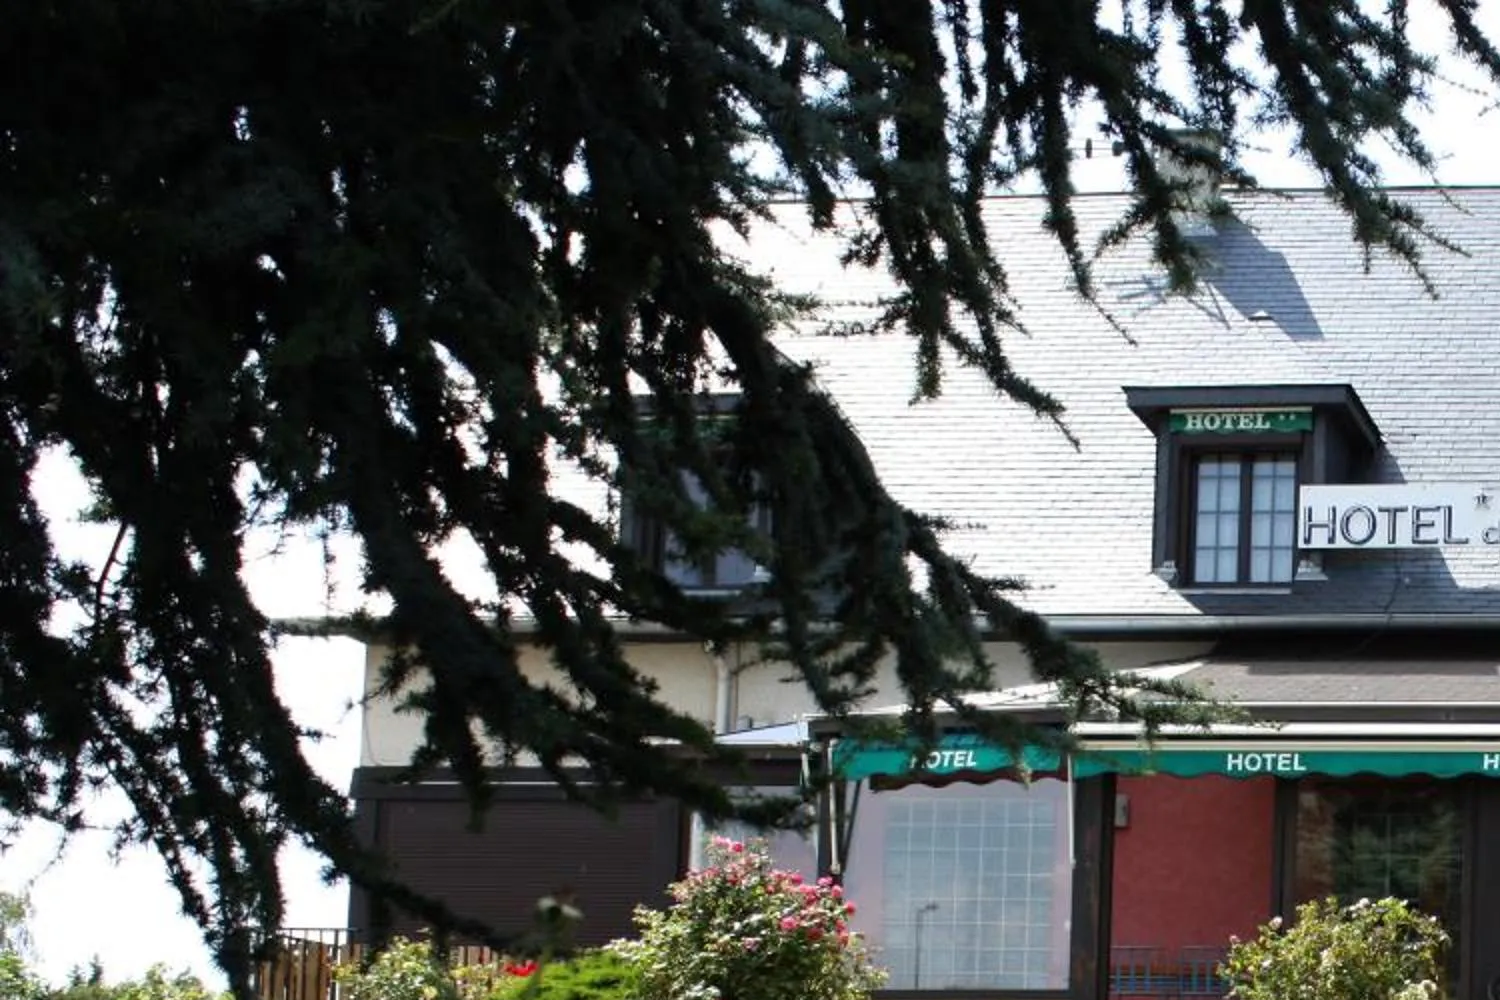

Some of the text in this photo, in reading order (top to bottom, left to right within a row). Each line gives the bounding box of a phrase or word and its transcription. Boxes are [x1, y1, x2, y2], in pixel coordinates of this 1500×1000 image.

[1184, 412, 1271, 430] HOTEL
[1302, 504, 1470, 546] HOTEL
[1227, 752, 1307, 772] HOTEL
